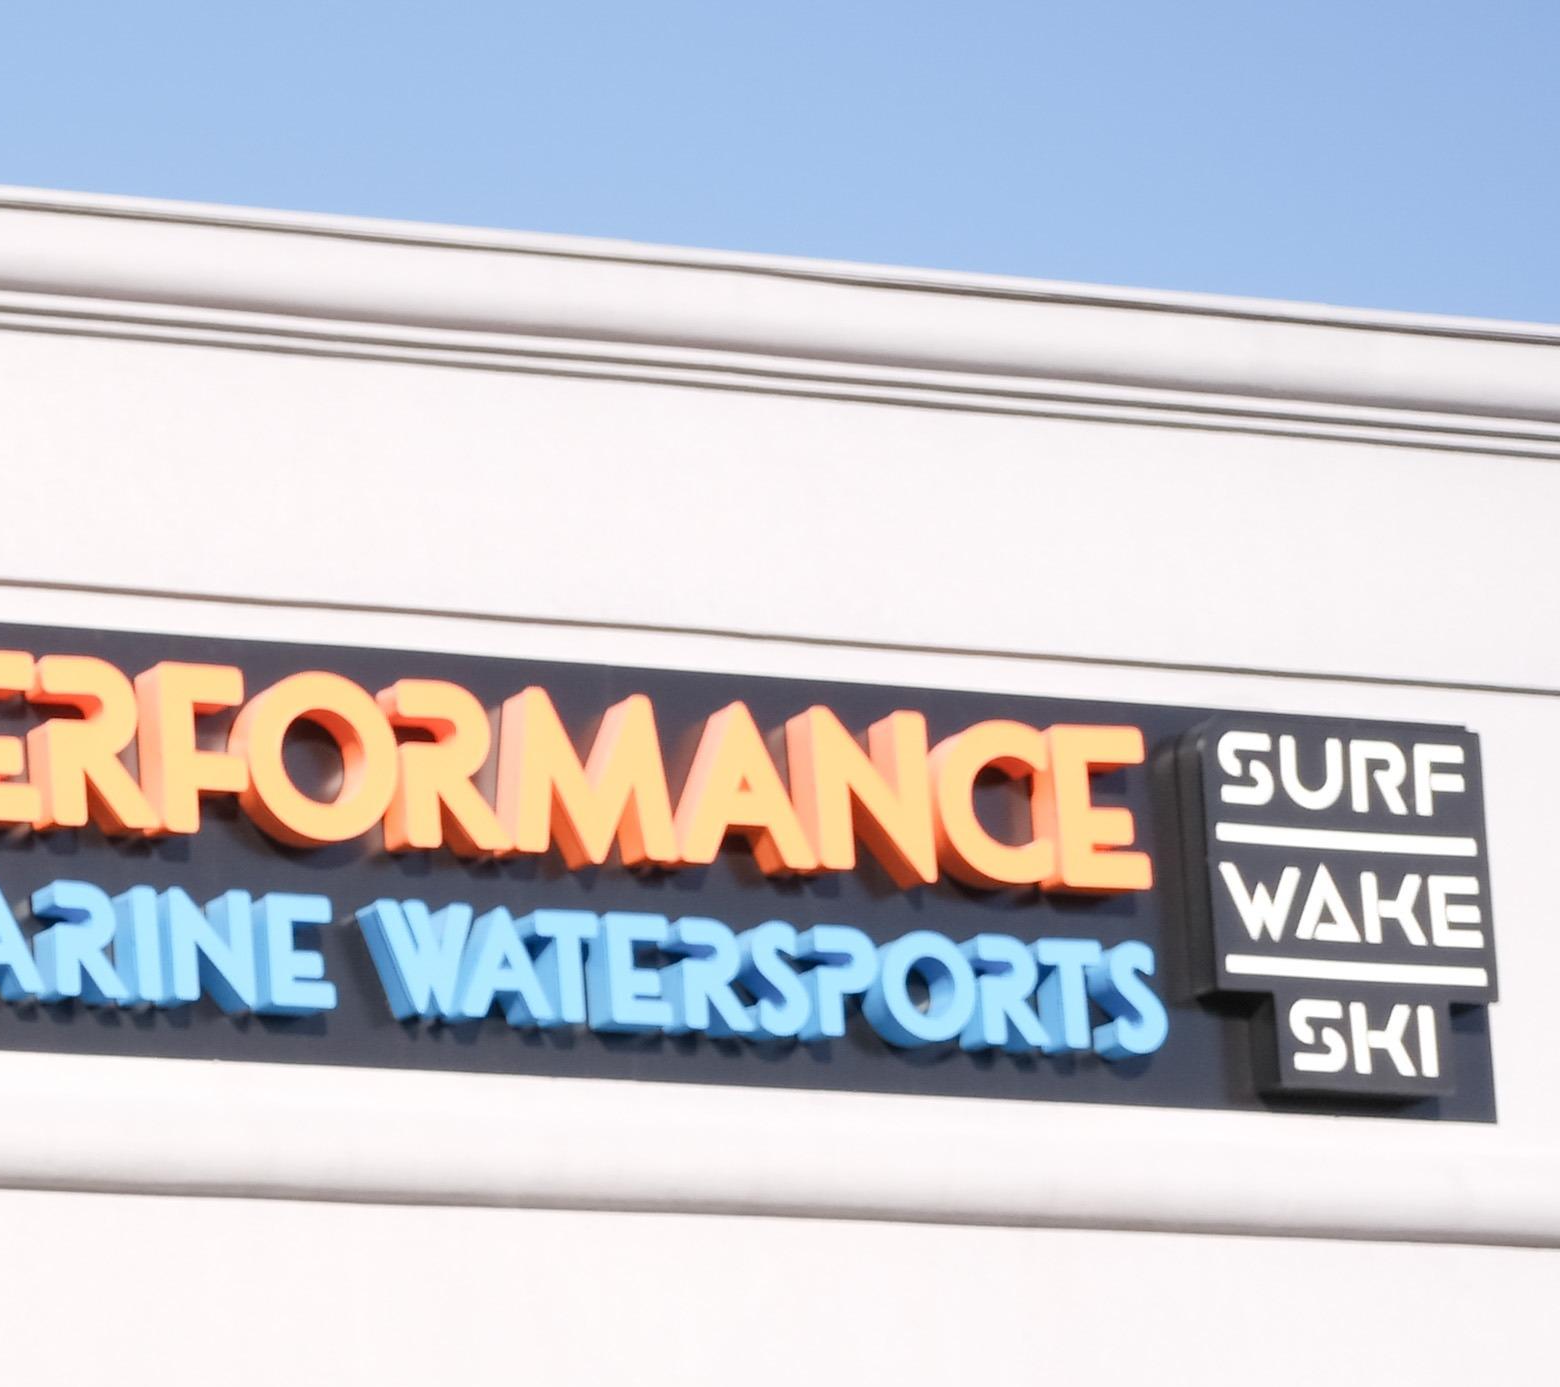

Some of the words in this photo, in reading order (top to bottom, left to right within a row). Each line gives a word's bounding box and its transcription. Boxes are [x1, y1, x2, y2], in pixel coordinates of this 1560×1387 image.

[1216, 729, 1467, 817] SURF
[1217, 860, 1485, 949] WAKE
[357, 898, 1169, 1056] WATERSPORTS
[1288, 997, 1440, 1079] SKI
